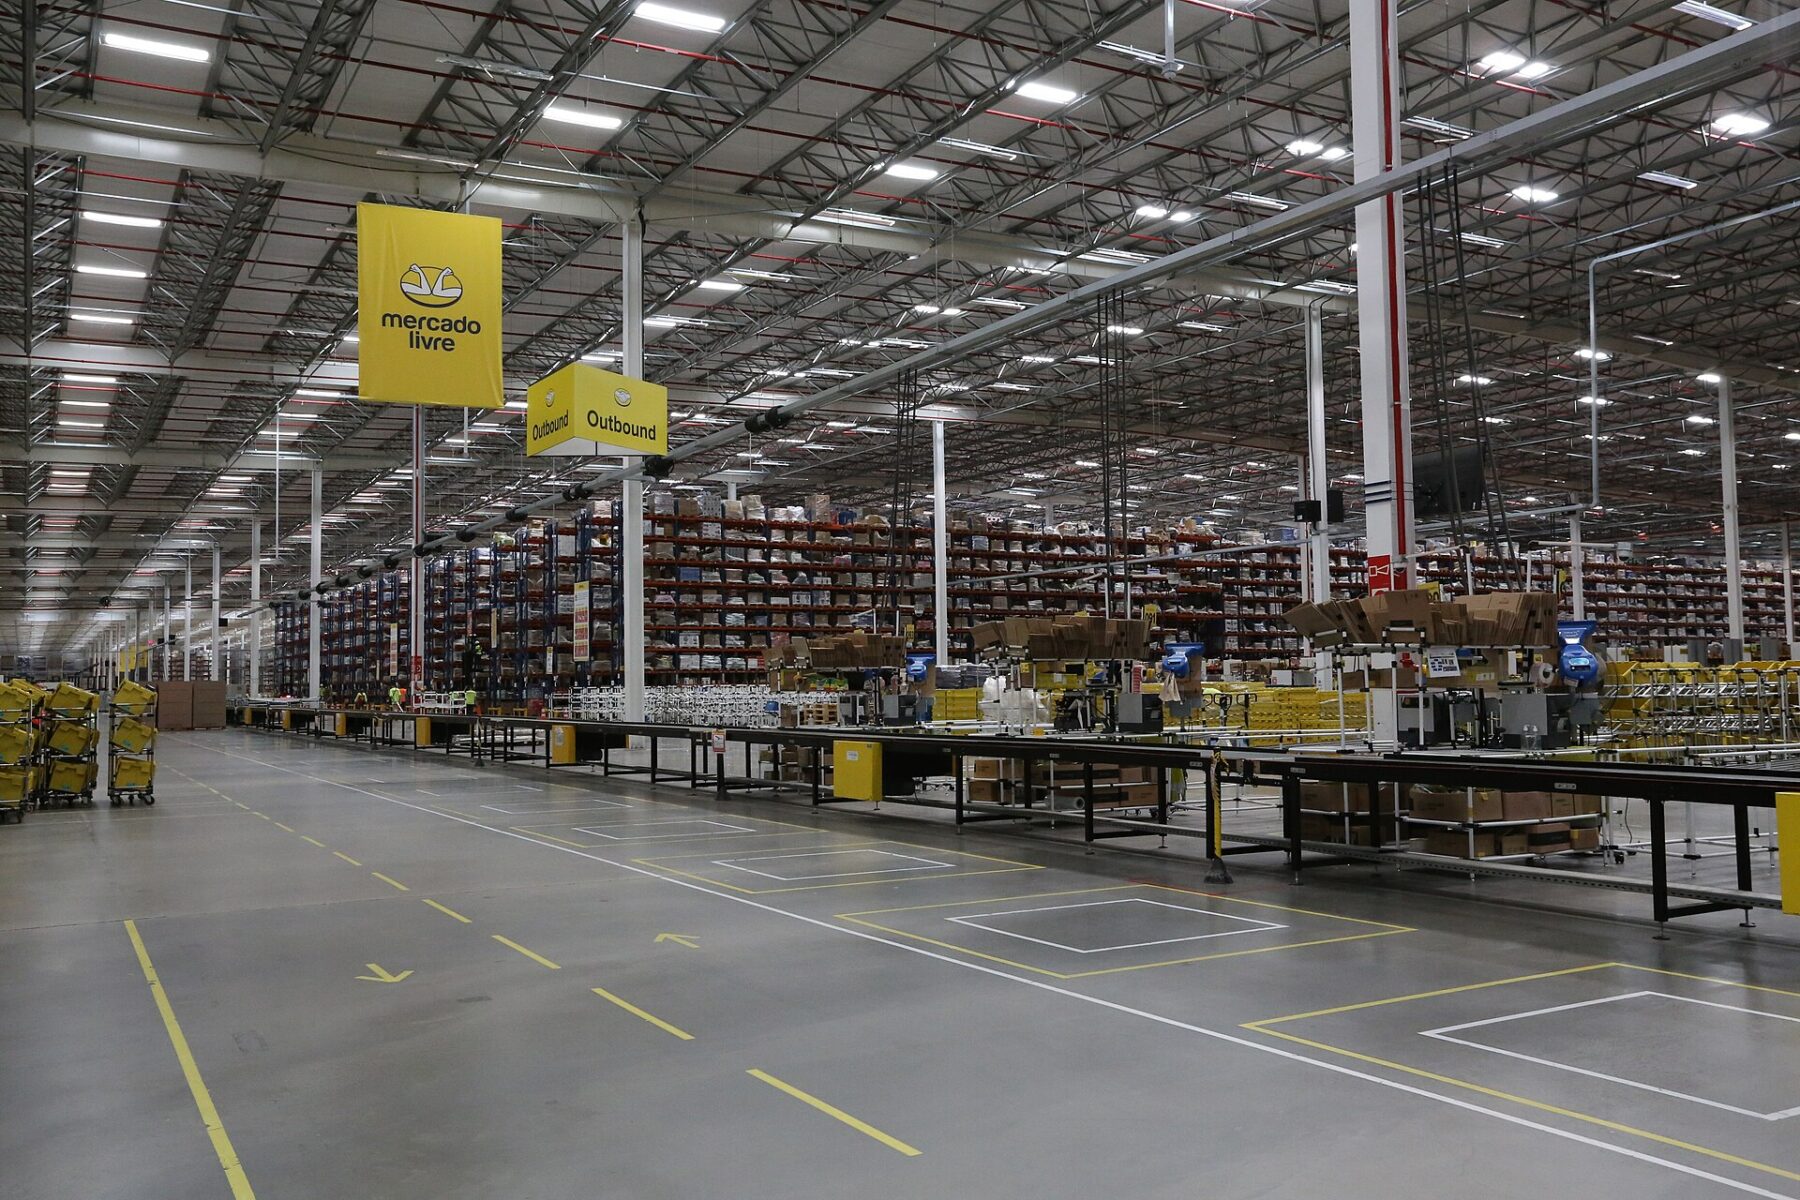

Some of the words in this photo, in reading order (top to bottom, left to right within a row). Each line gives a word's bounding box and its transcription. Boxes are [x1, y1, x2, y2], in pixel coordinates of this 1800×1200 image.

[382, 313, 481, 334] mercado
[409, 330, 455, 351] livre
[532, 409, 569, 441] Outbound
[587, 409, 656, 440] Outbound
